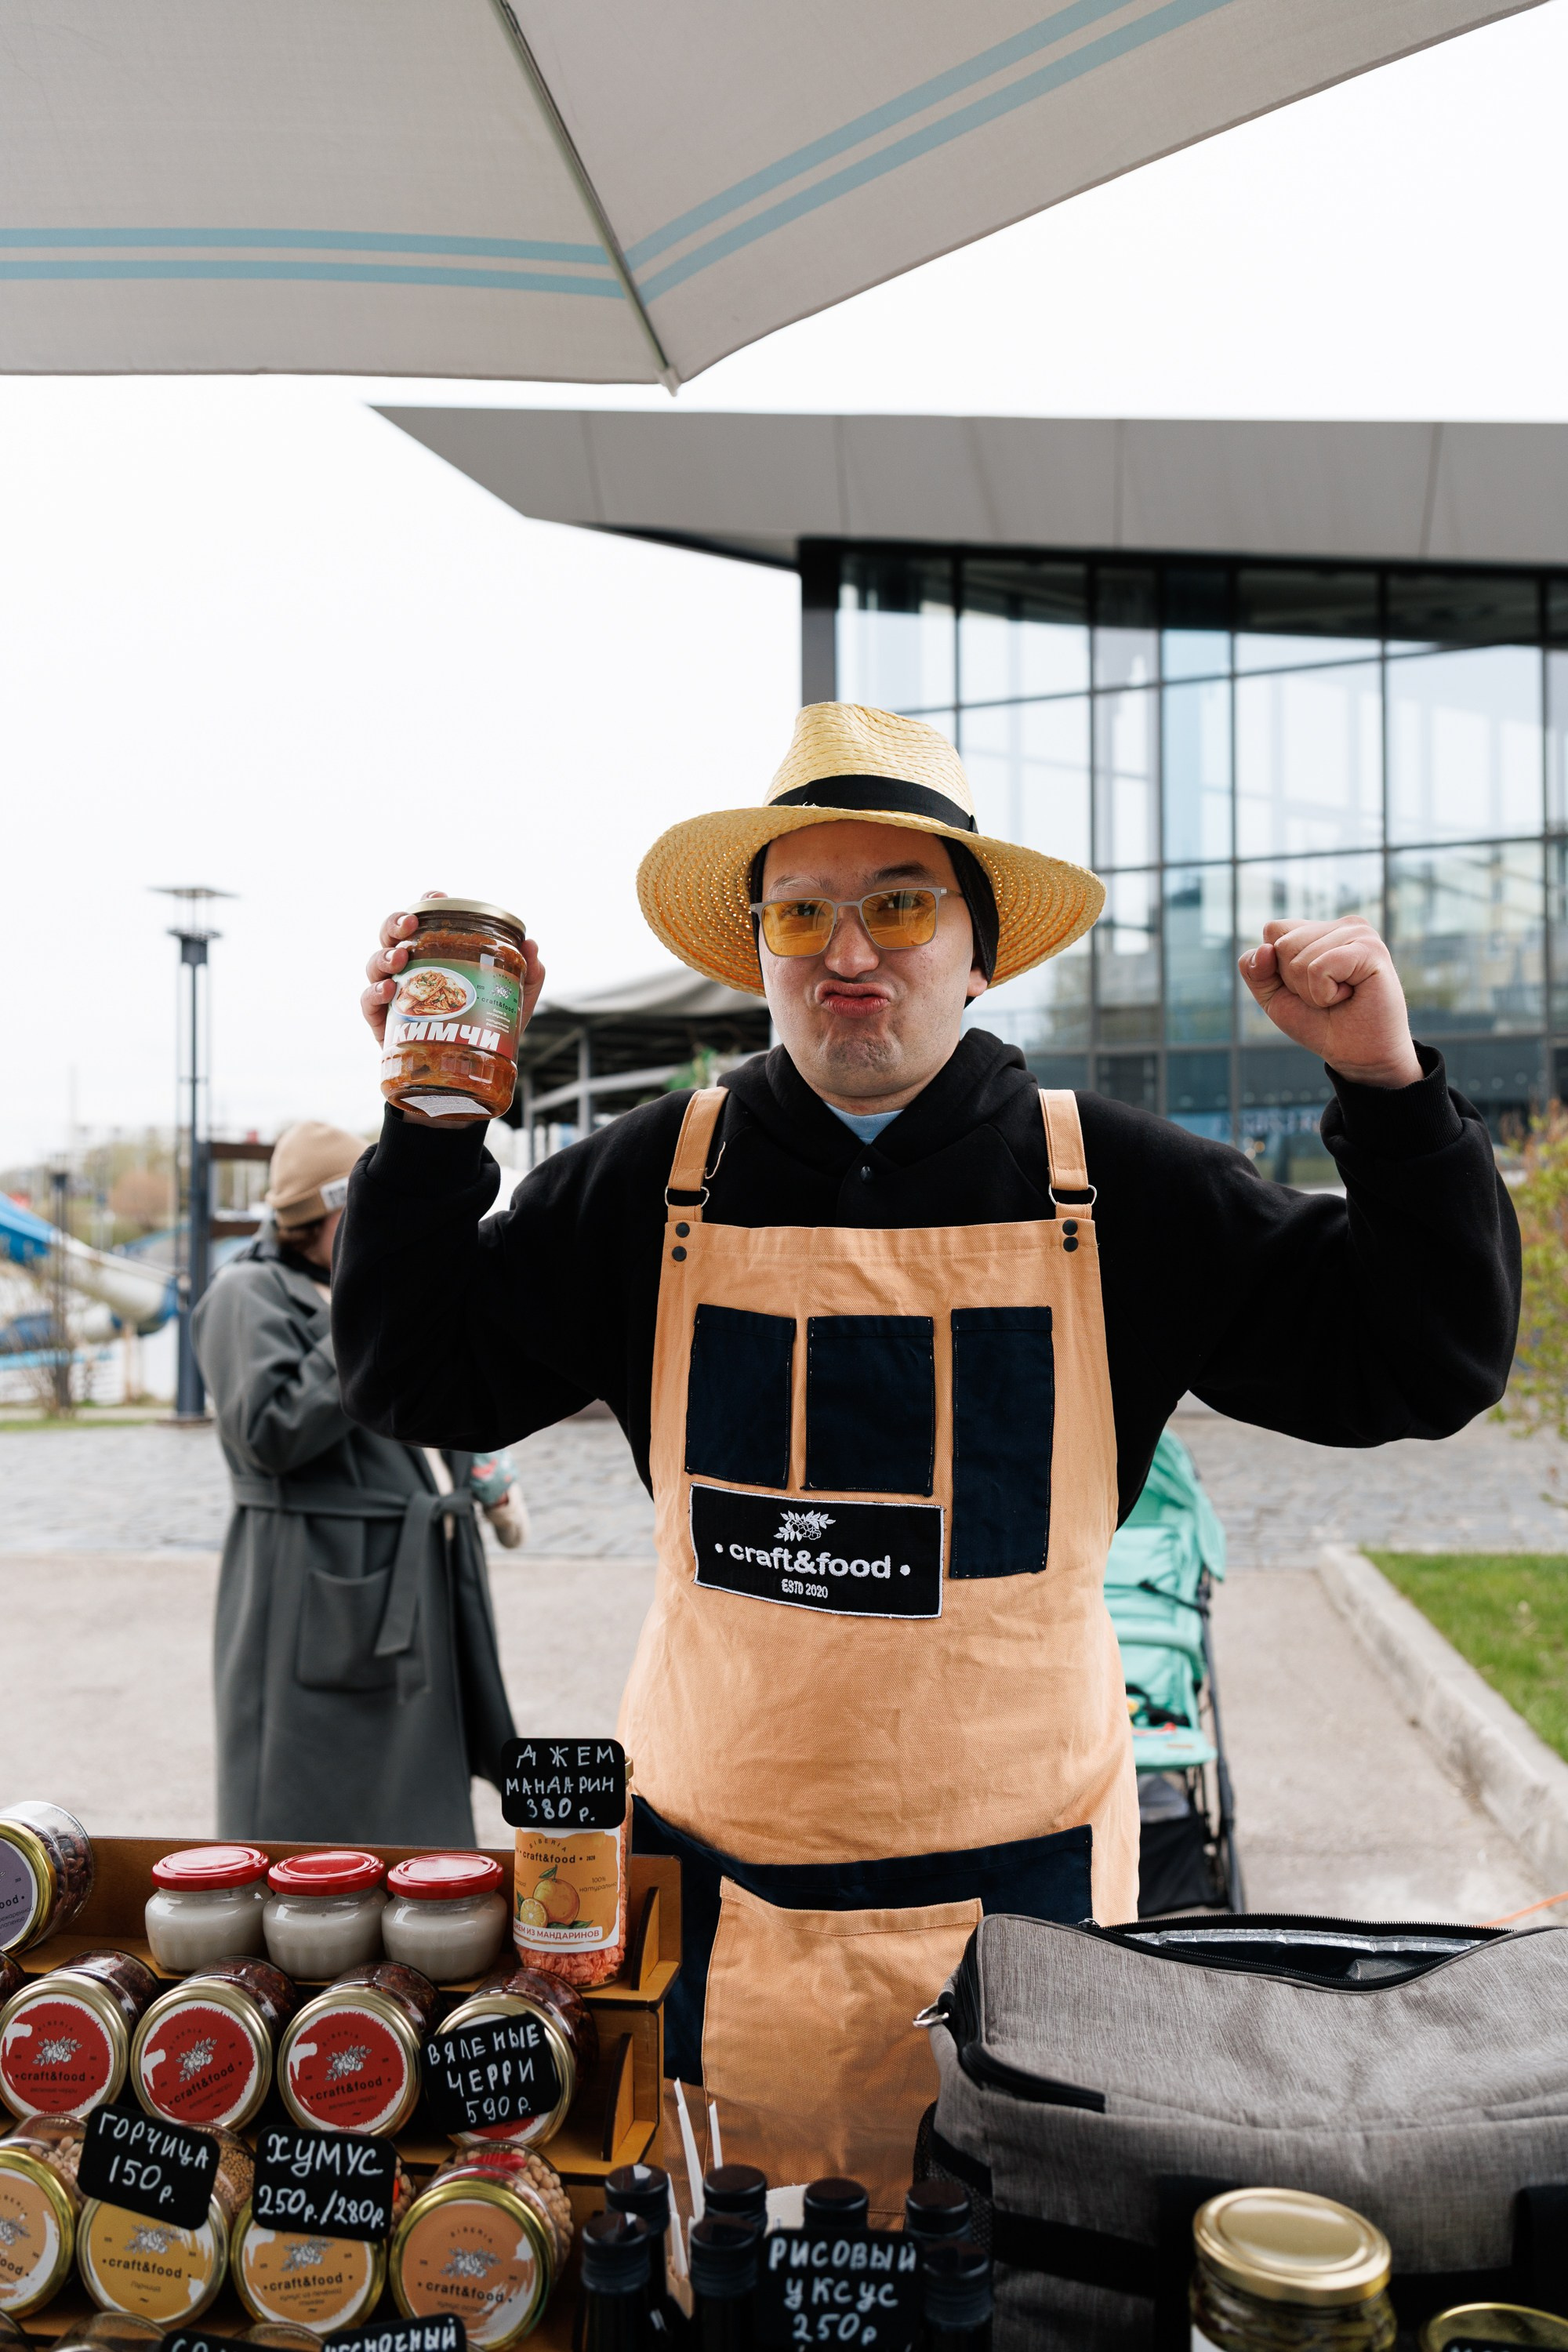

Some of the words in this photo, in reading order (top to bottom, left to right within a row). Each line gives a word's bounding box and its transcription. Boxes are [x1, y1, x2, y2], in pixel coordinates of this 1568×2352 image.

[481, 996, 514, 1014] craft&food
[392, 1022, 501, 1052] КИМЧИ
[729, 1543, 891, 1579] craft&food
[781, 1578, 804, 1595] ESTD
[805, 1581, 829, 1599] 2020
[516, 1744, 615, 1769] ДЖЕМ
[506, 1775, 615, 1797] МАНДАРИН
[528, 1838, 567, 1853] SIBERIA
[522, 1851, 576, 1864] craft&food
[0, 1905, 34, 1922] ежаренной
[0, 1916, 25, 1929] лапеньо
[536, 1929, 600, 1940] МАНДАРИНОВ
[20, 2071, 86, 2082] craft&food
[174, 2062, 235, 2104] craft&food
[446, 2056, 535, 2098] ЧЕРРИ
[315, 2075, 383, 2101] craft&food
[98, 2111, 210, 2170] ГОРЧИЦА
[266, 2132, 384, 2179] ХУМУС
[768, 2236, 917, 2272] РИСОВЫЙ
[108, 2257, 183, 2279] craft&food
[269, 2273, 343, 2292] craft&food
[426, 2281, 504, 2303] craft&food
[783, 2276, 899, 2313] УКСУС
